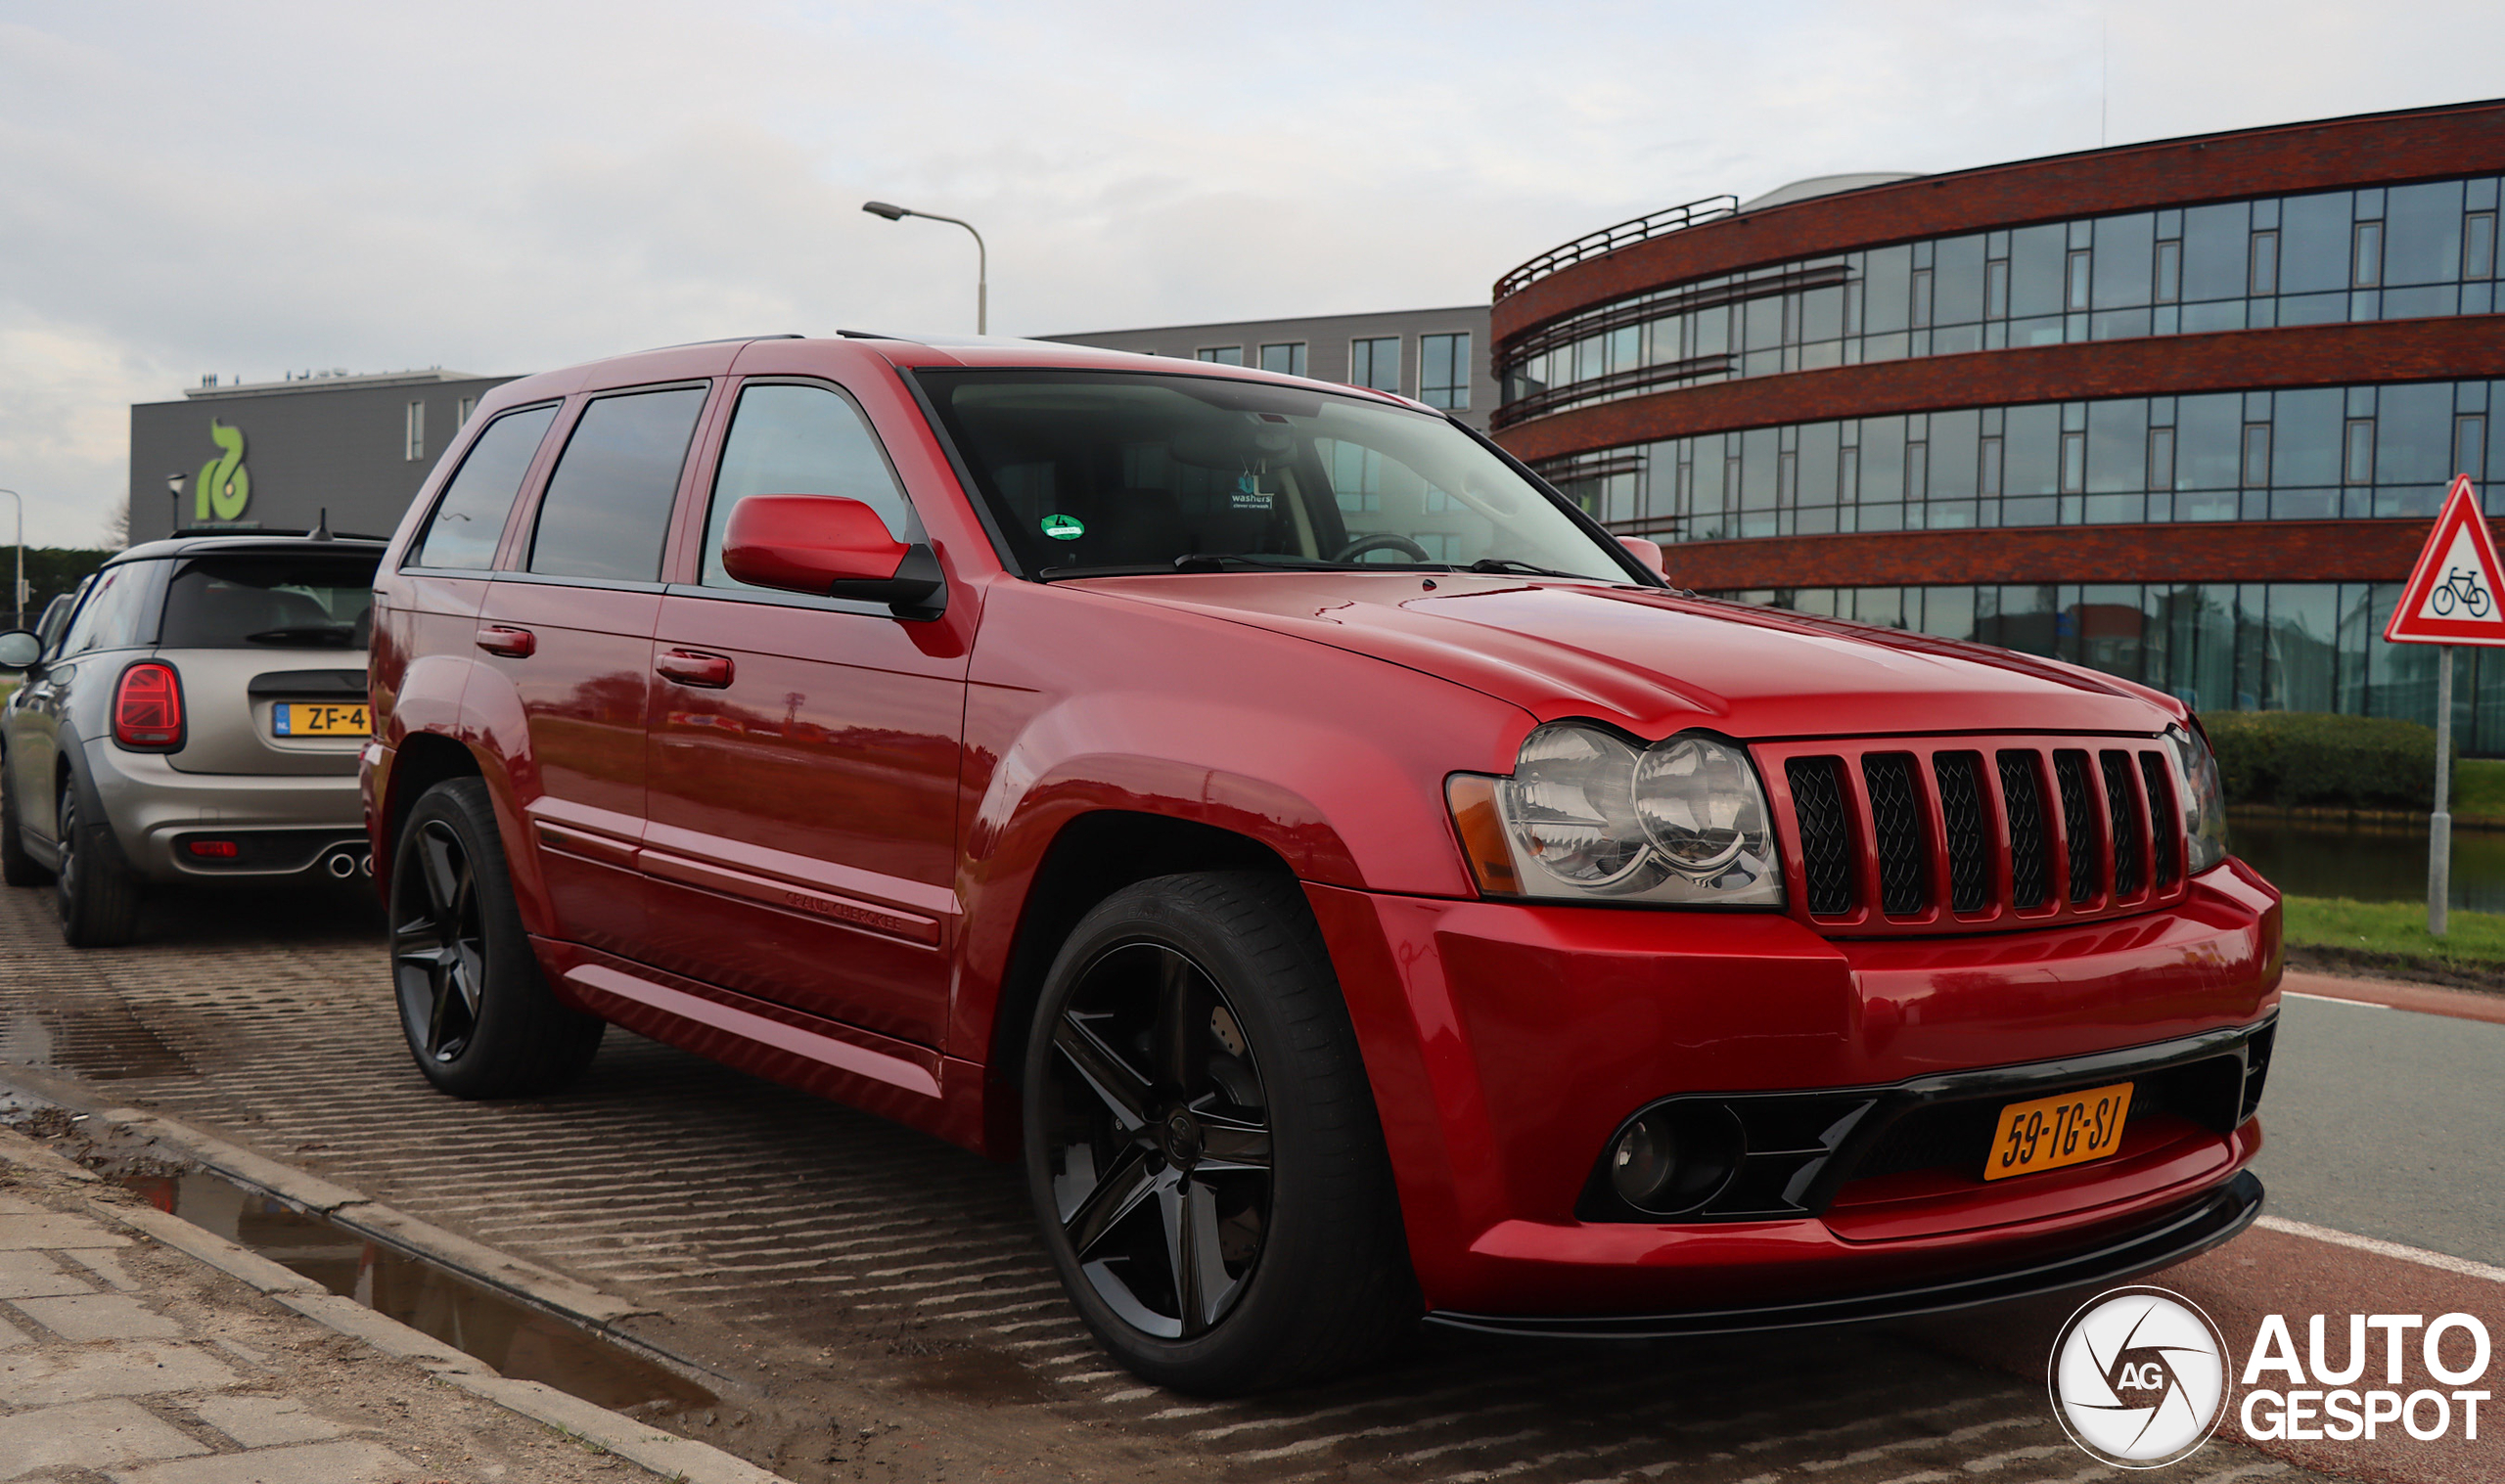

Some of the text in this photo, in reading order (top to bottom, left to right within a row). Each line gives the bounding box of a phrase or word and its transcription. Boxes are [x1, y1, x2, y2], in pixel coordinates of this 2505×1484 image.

[1056, 516, 1068, 526] 4
[308, 708, 369, 730] ZF-4
[786, 891, 901, 932] GRAND CHEROKEE
[2002, 1095, 2121, 1167] 59-TG-SJ
